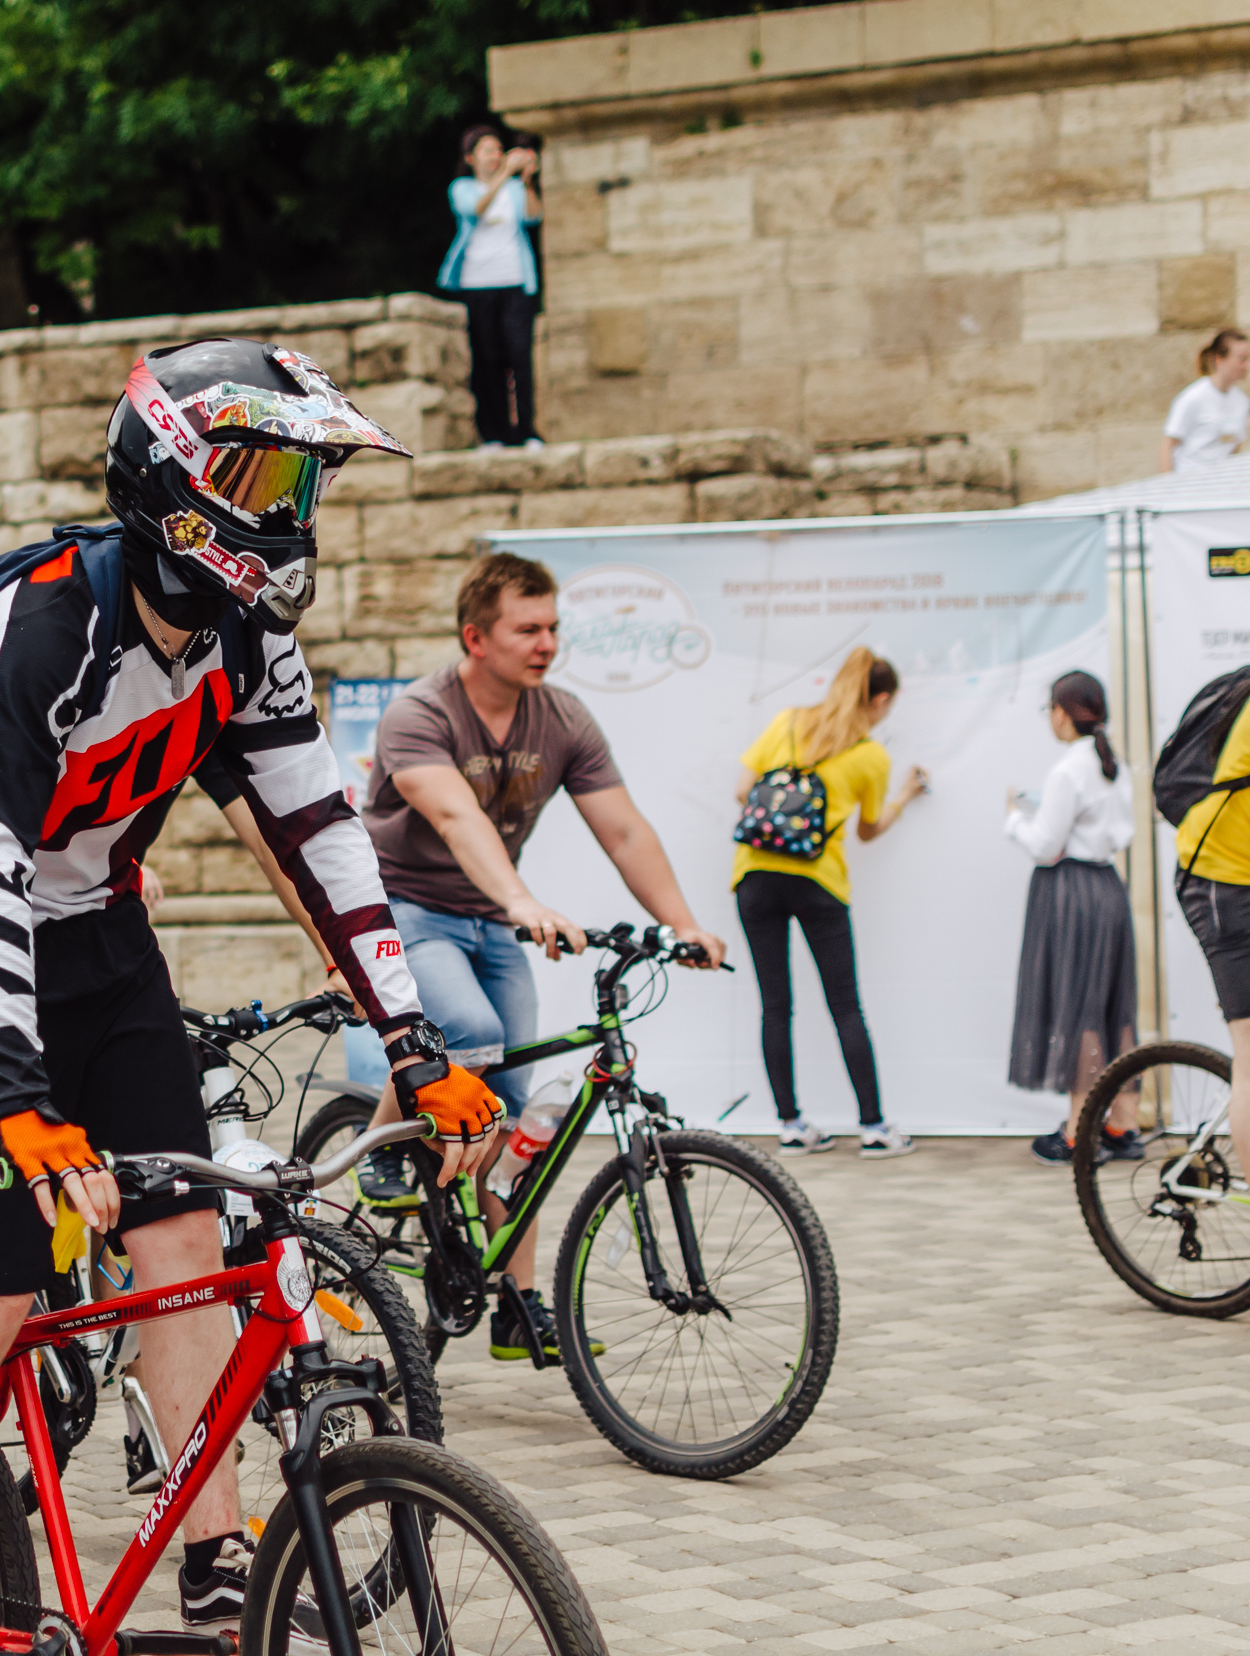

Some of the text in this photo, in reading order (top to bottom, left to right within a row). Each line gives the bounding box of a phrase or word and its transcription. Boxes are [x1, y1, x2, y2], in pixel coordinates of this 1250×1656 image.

[205, 547, 224, 564] STYLE
[376, 940, 401, 959] FOX
[281, 1169, 309, 1180] WAKE
[299, 1236, 352, 1274] ERIDA
[157, 1287, 215, 1310] INSANE
[59, 1321, 75, 1329] THIS
[83, 1316, 98, 1324] THE
[98, 1312, 117, 1321] BEST
[139, 1421, 206, 1548] MAXXPRO
